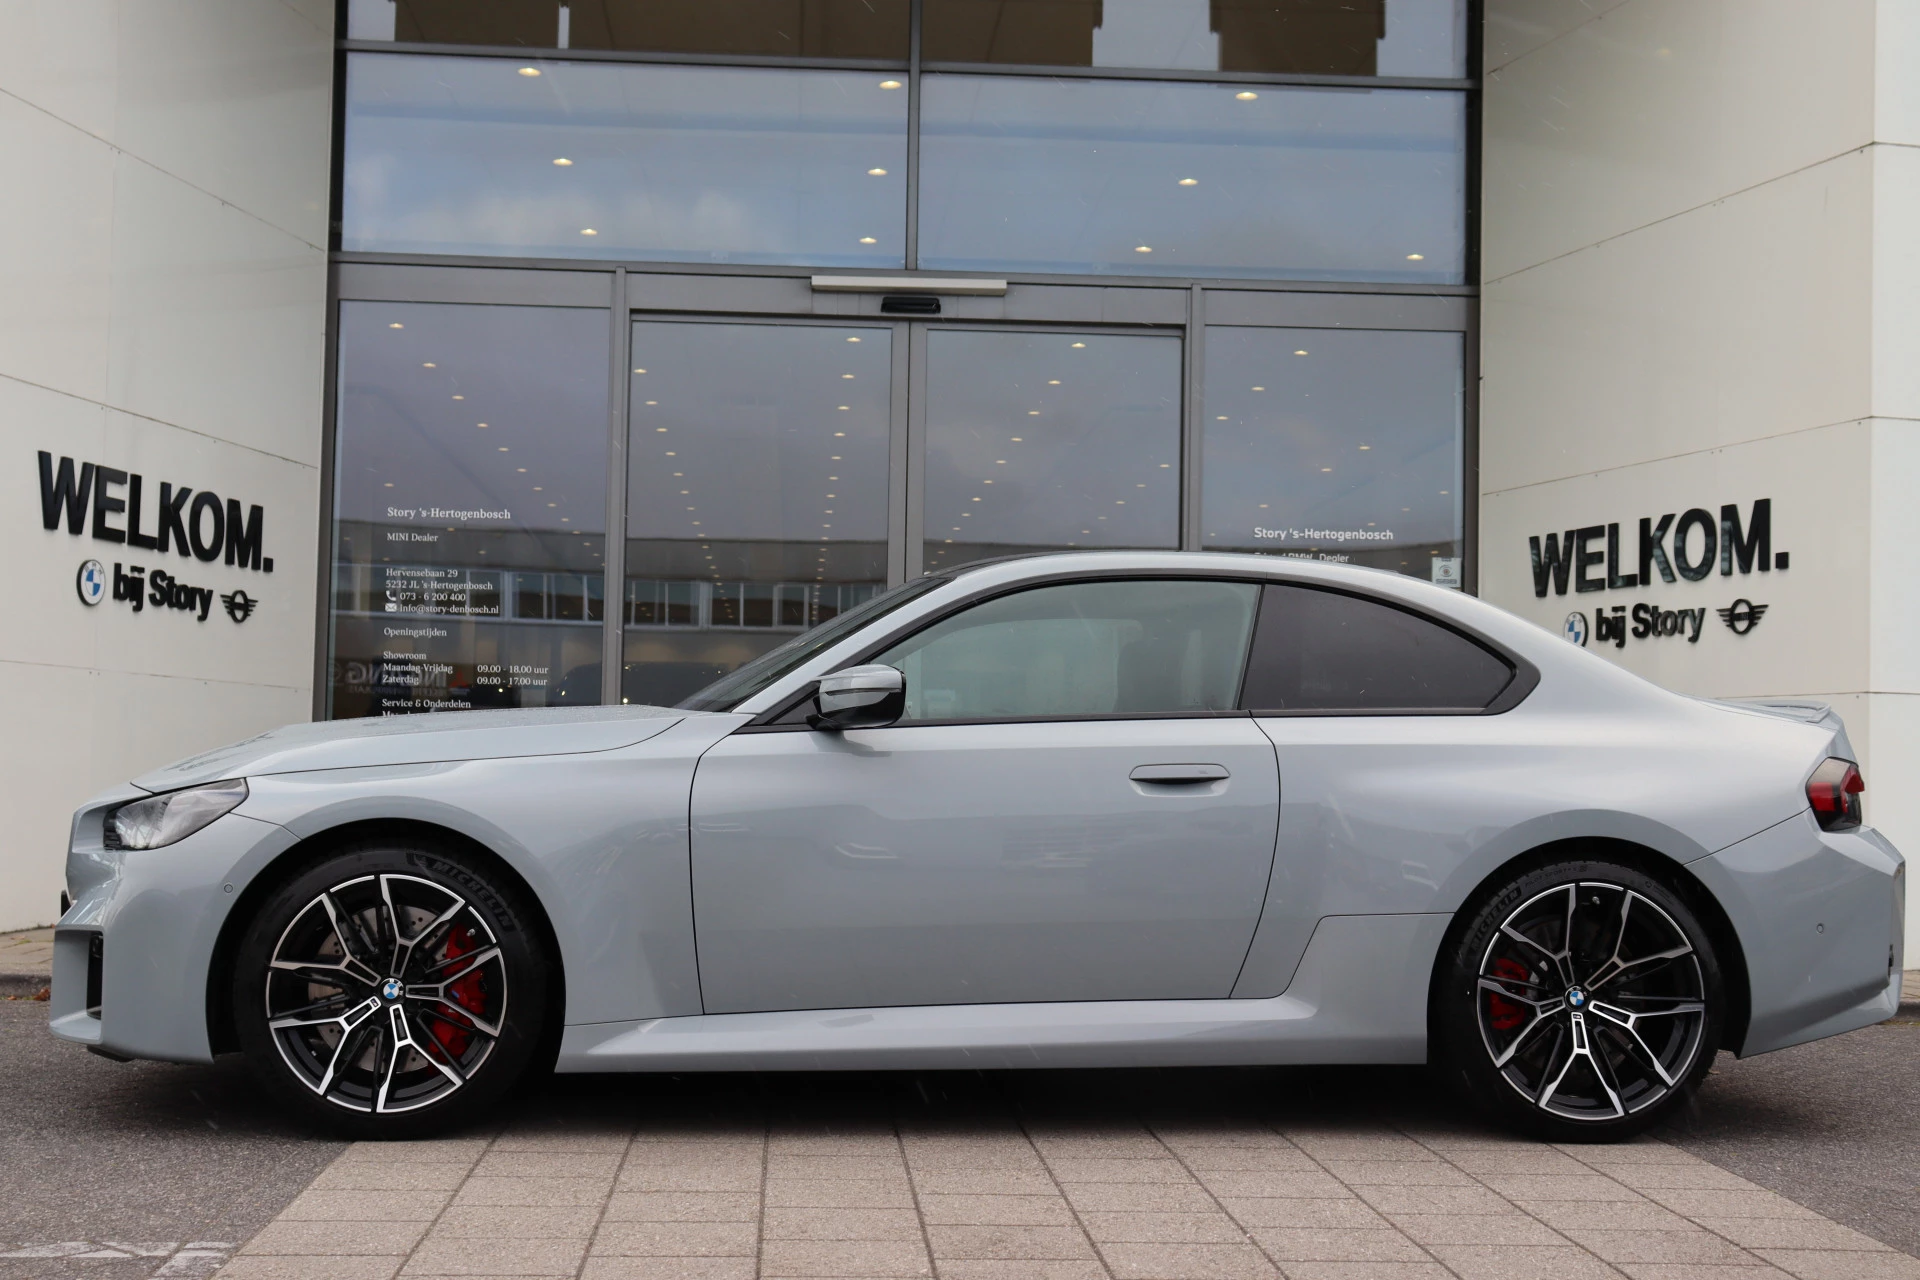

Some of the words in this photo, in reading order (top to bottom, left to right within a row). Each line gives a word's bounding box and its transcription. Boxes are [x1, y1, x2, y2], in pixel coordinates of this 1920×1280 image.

[38, 450, 274, 572] WELKOM.
[387, 507, 416, 519] Story
[387, 533, 409, 541] MINI
[411, 533, 438, 542] Dealer
[1254, 527, 1286, 540] Story
[1290, 528, 1394, 541] 's-Hertogenbosch
[1529, 498, 1789, 598] WELKOM.
[1319, 554, 1349, 563] Dealer
[386, 568, 445, 578] Hervensebaan
[447, 569, 458, 578] 29
[385, 580, 407, 589] 5232
[409, 580, 419, 589] JL
[421, 581, 493, 591] 's-Hertogenbosch
[113, 562, 145, 612] bij
[148, 569, 214, 621] Story
[400, 592, 416, 601] 073
[423, 592, 429, 601] 6
[432, 592, 448, 601] 200
[450, 592, 466, 601] 400
[400, 603, 499, 615] info@story-denbosch.nl
[1596, 605, 1626, 648] bij
[1631, 603, 1706, 643] Story
[383, 627, 447, 638] Openingstijden
[383, 651, 427, 660] Showroom
[383, 663, 453, 674] Maandag-Vrijdag
[477, 665, 501, 673] 09.00
[509, 665, 532, 673] 18.00
[382, 675, 419, 685] Zaterdag
[476, 677, 501, 685] 09.00
[509, 677, 531, 686] 17.00
[382, 698, 413, 707] Service
[415, 699, 421, 707] &
[423, 699, 471, 708] Onderdelen
